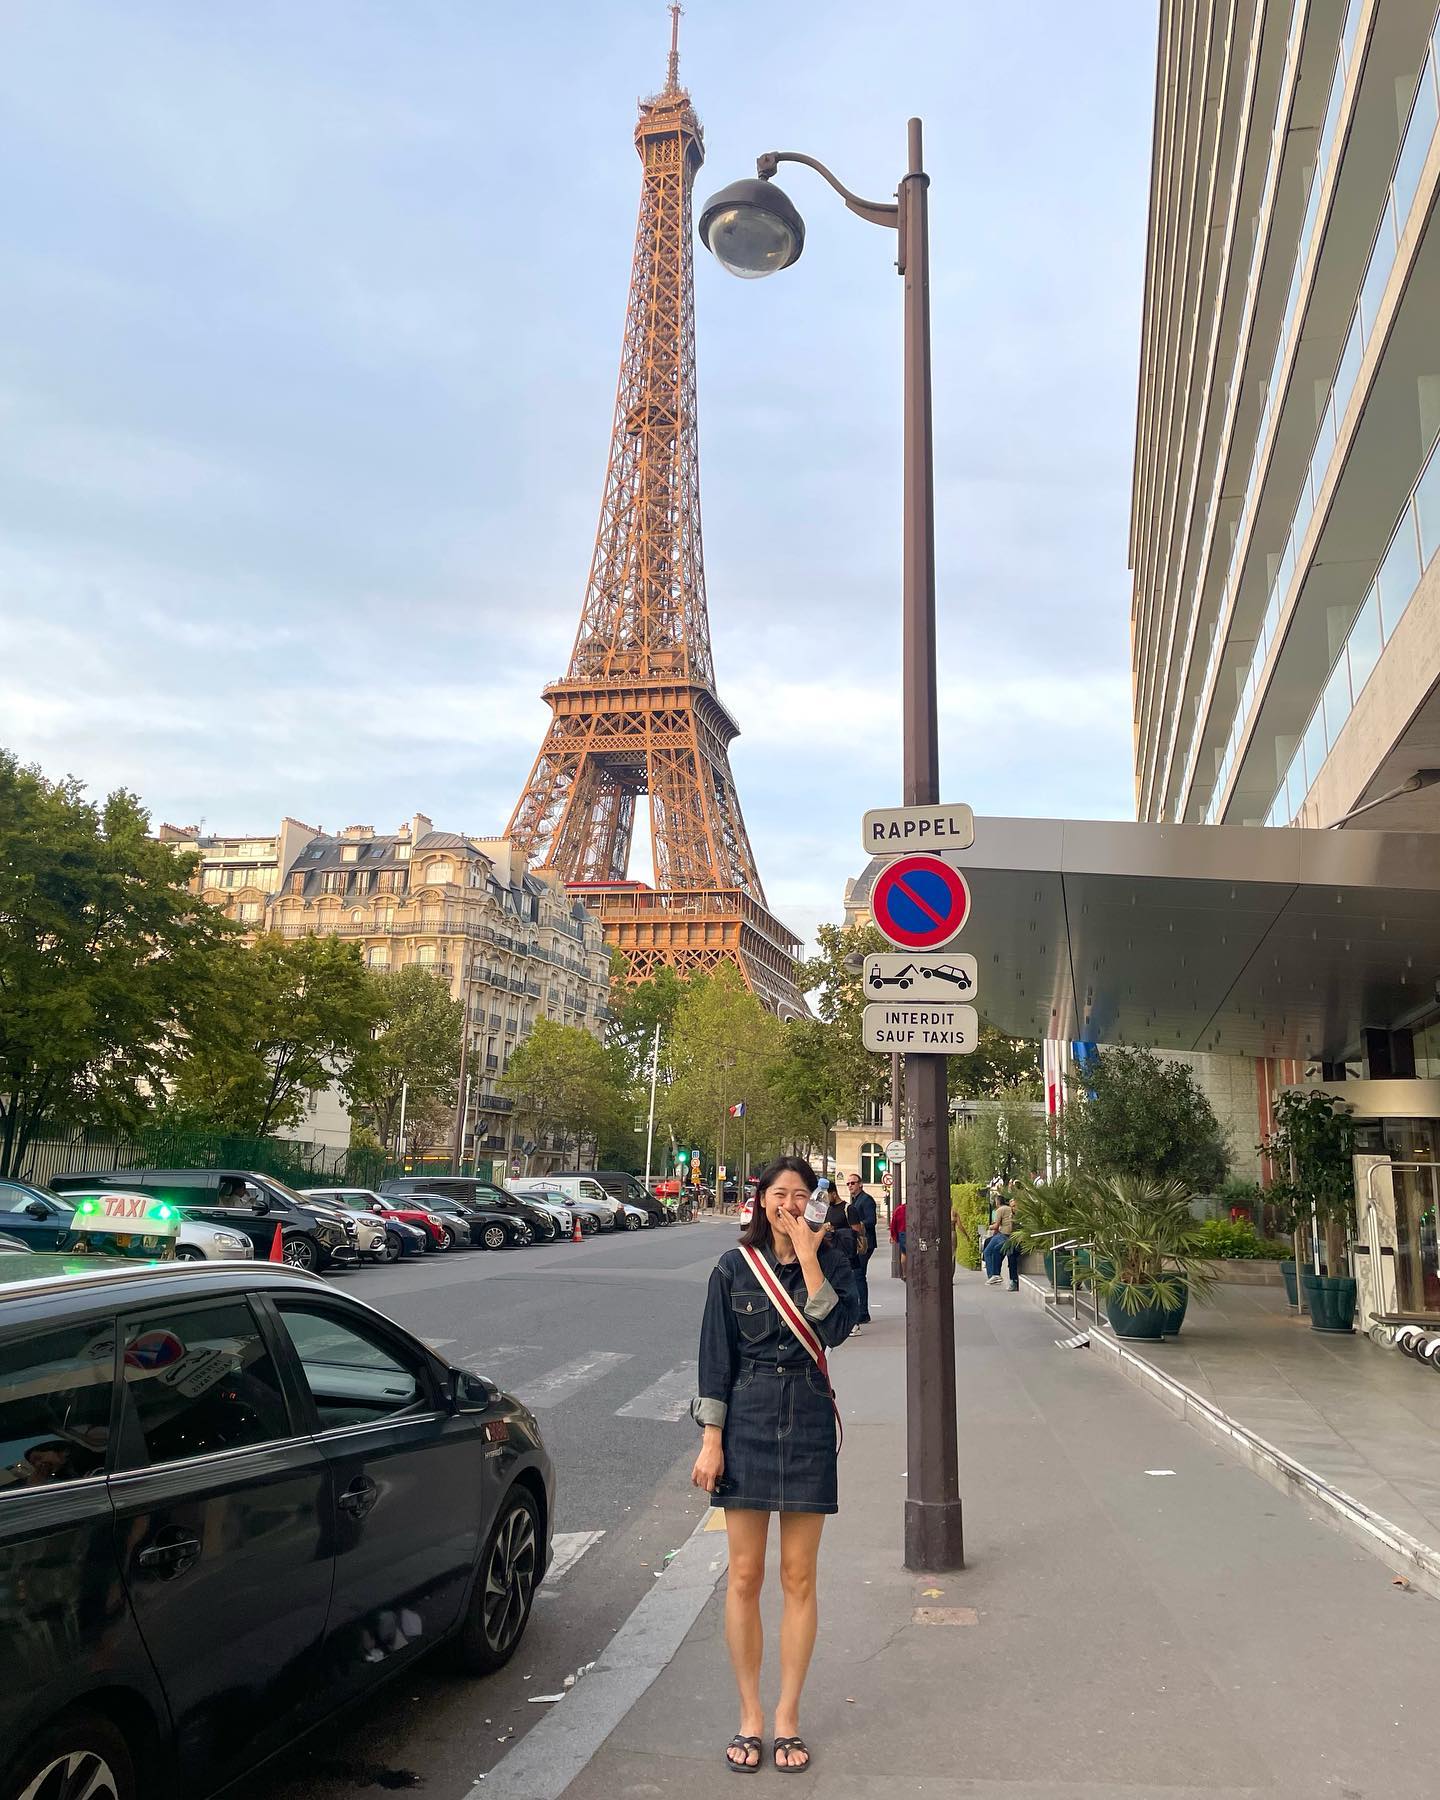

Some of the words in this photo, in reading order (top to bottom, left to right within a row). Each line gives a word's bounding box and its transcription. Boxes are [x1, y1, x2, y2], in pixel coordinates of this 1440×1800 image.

[873, 817, 960, 840] RAPPEL
[885, 1012, 955, 1025] INTERDIT
[876, 1030, 915, 1042] SAUF
[922, 1031, 965, 1044] TAXIS
[105, 1199, 147, 1217] TAXI
